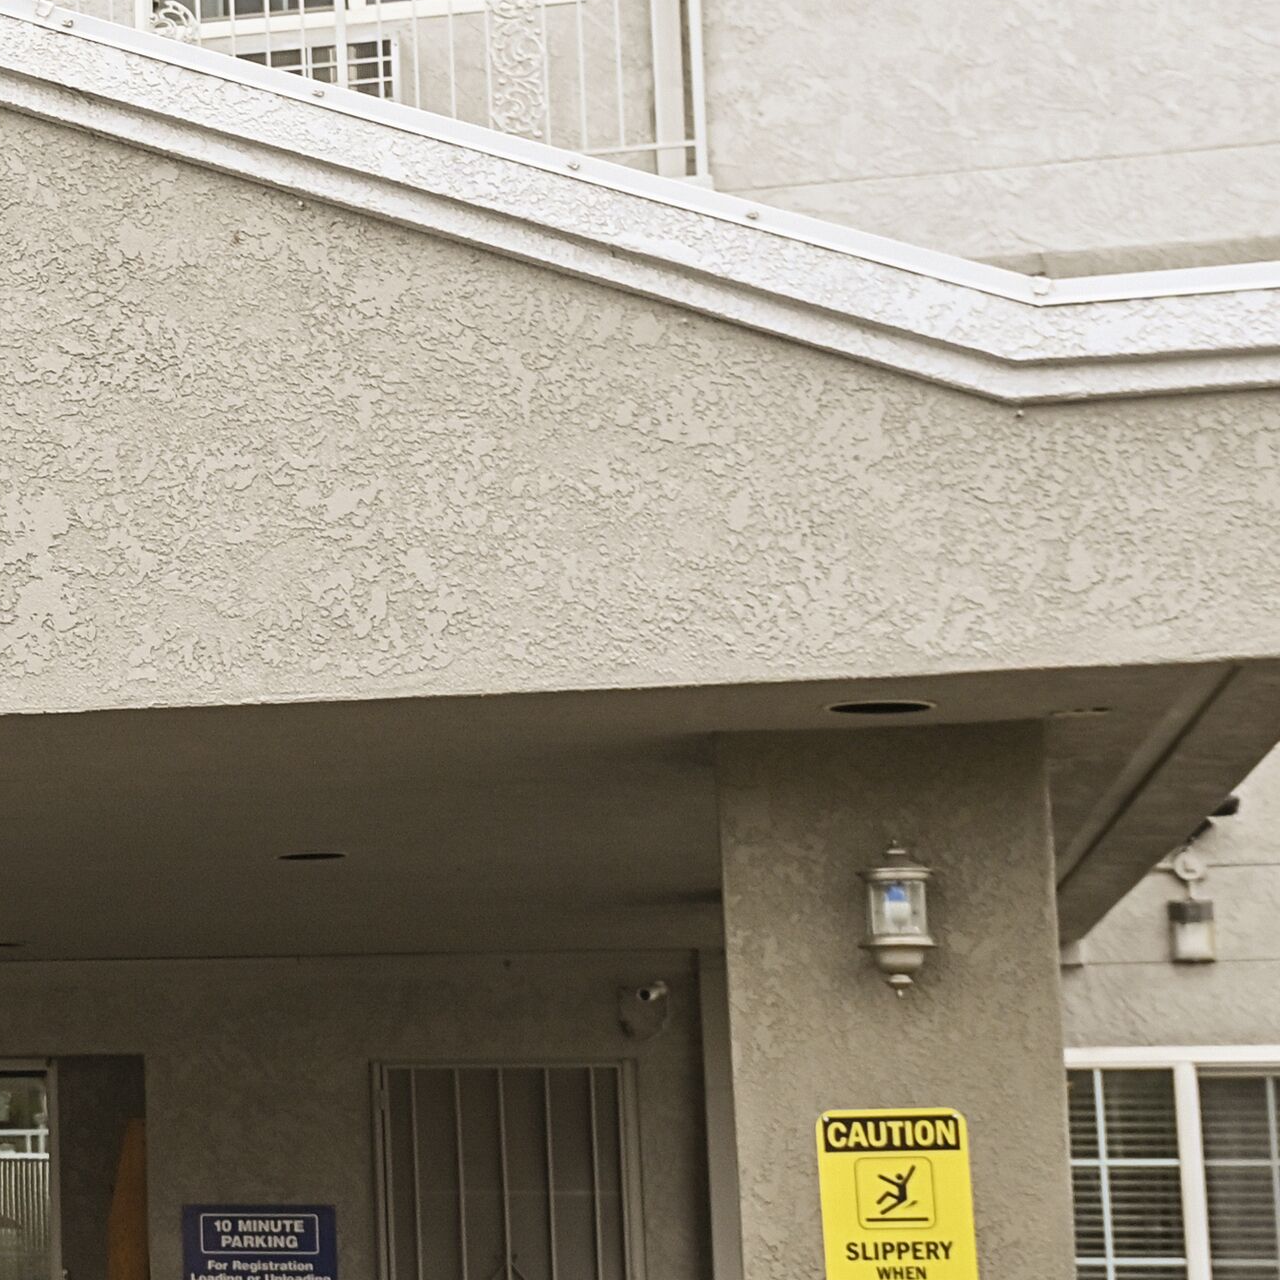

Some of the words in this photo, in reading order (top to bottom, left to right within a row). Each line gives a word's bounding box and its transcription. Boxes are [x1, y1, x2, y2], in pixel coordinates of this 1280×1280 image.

[827, 1120, 957, 1148] CAUTION
[214, 1219, 232, 1233] 10
[238, 1220, 304, 1233] MINUTE
[221, 1235, 298, 1248] PARKING
[845, 1240, 953, 1261] SLIPPERY
[207, 1259, 228, 1270] For
[232, 1260, 313, 1272] Registration
[876, 1266, 927, 1280] WHEN
